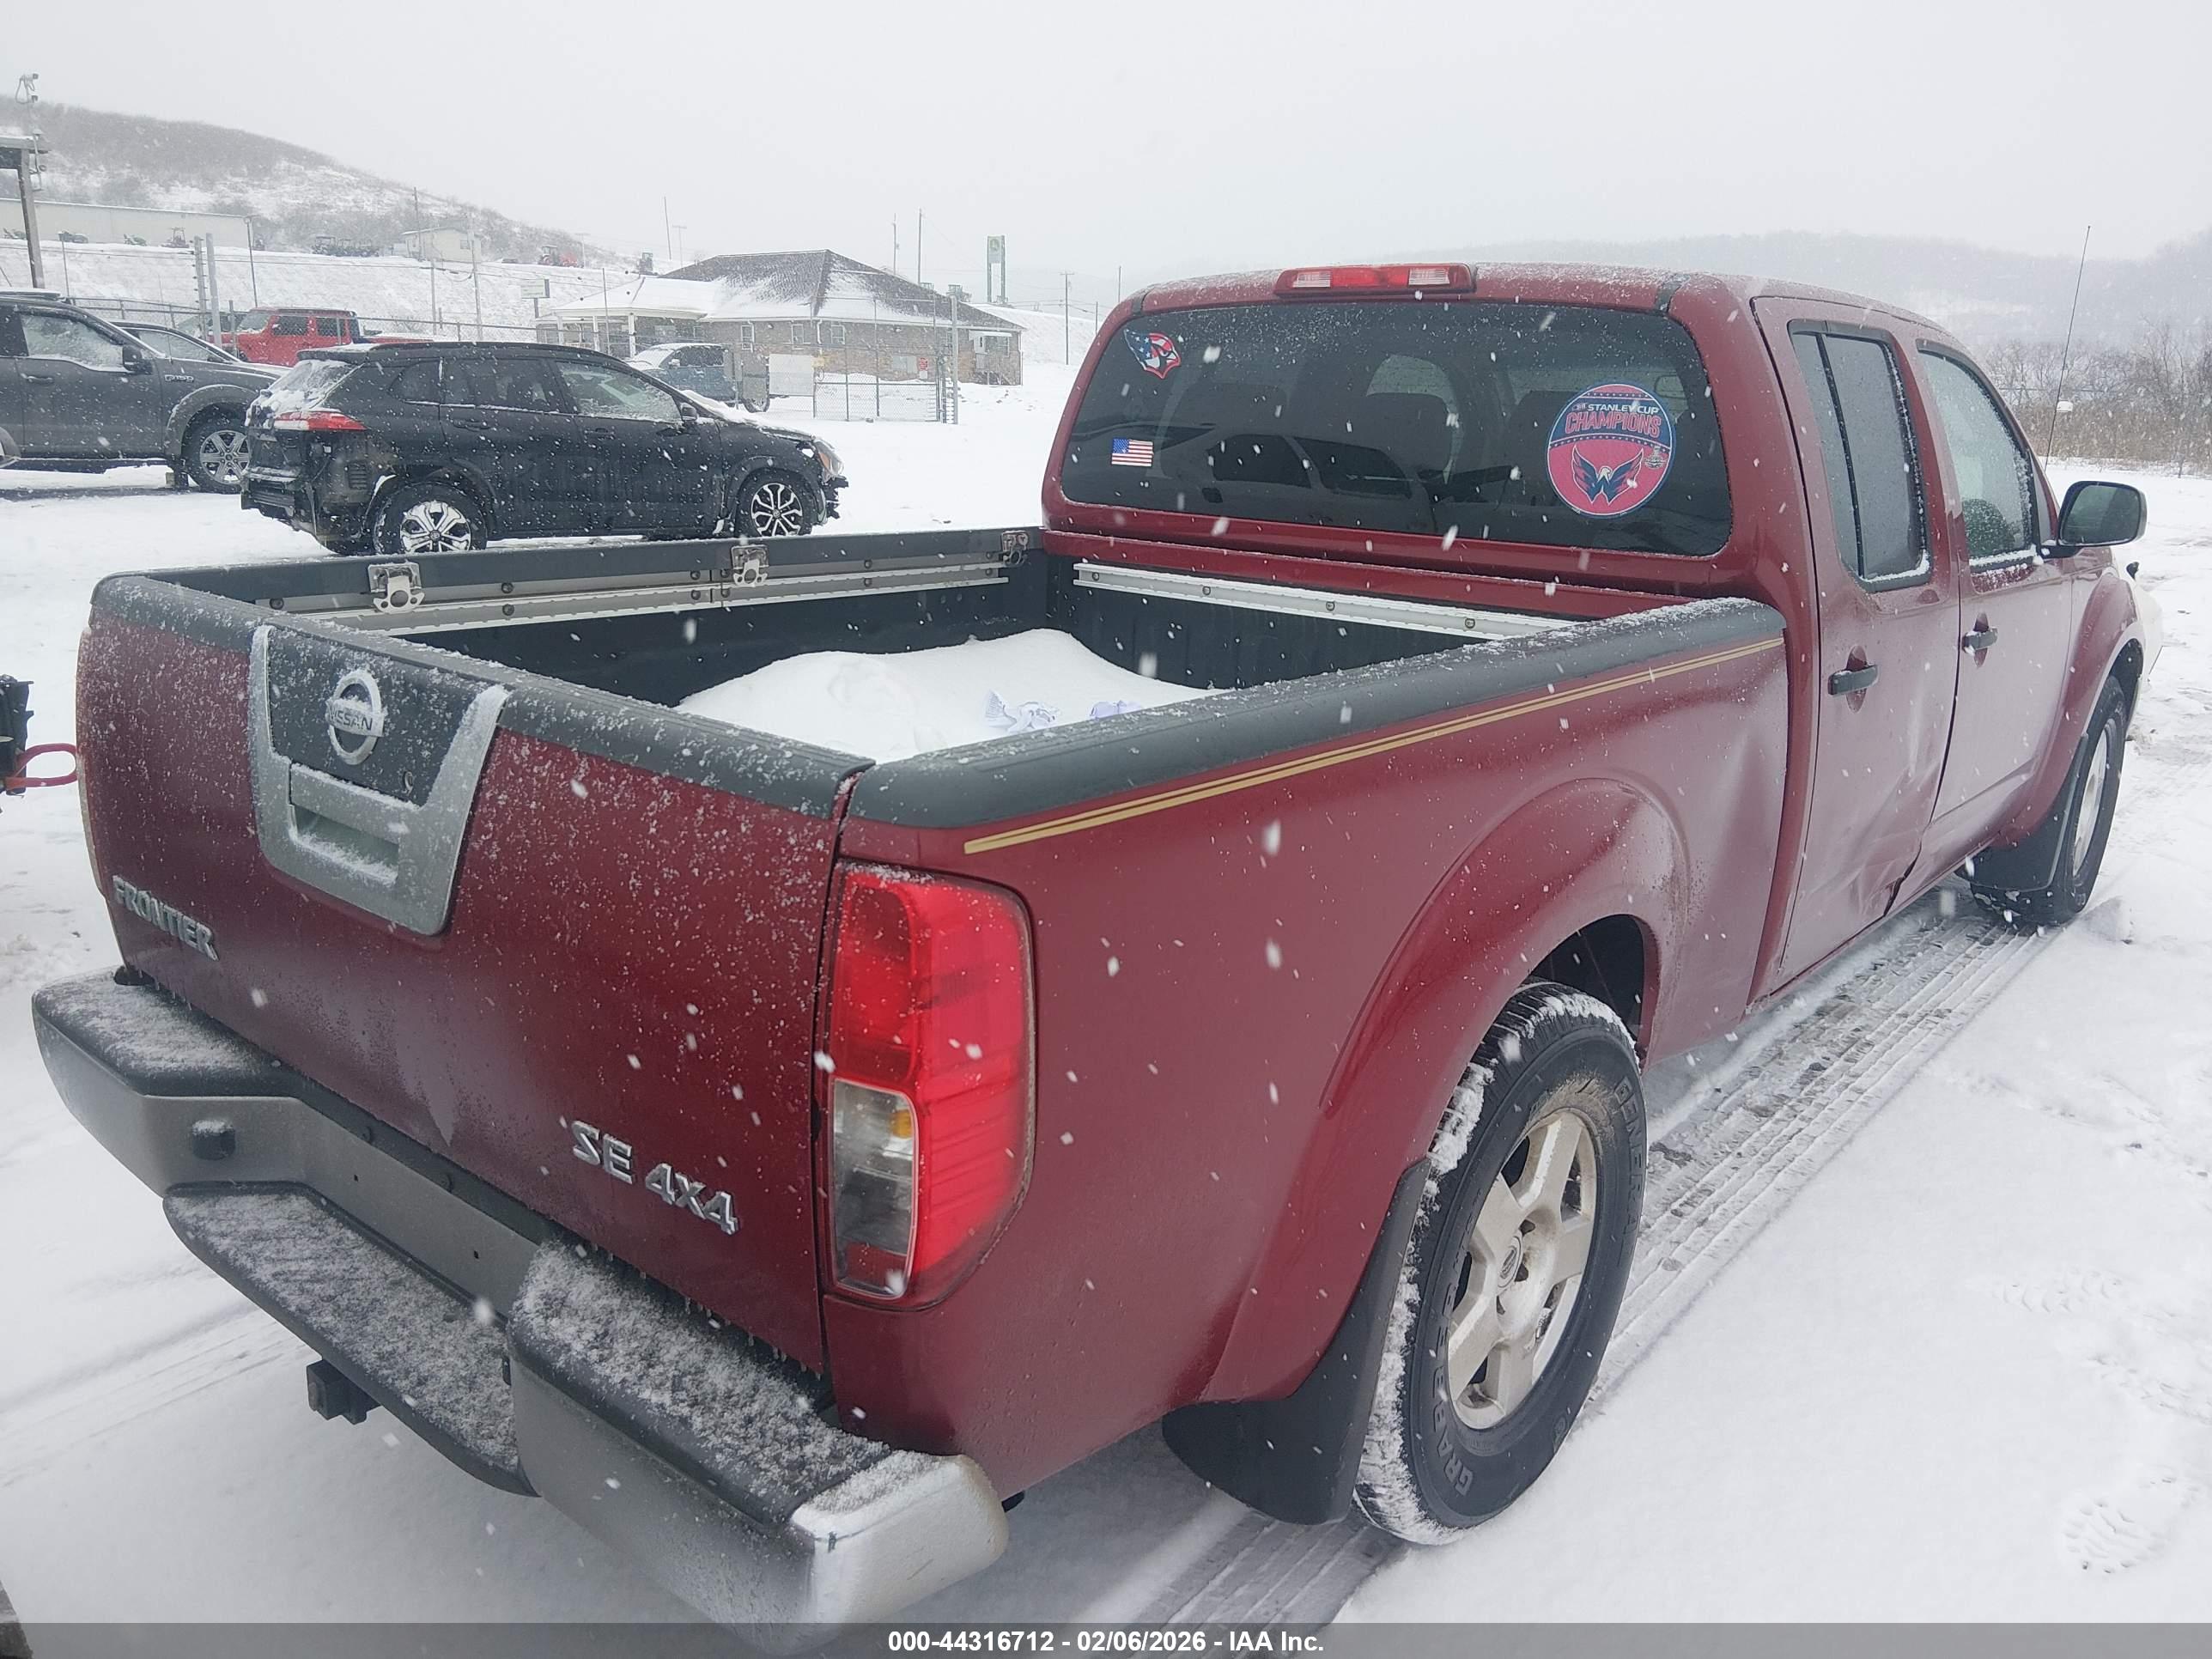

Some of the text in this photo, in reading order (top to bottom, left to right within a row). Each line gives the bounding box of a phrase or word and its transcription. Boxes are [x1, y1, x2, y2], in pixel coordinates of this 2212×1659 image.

[1565, 411, 1662, 438] CHAMPIONS
[1588, 403, 1638, 413] STANLEY
[1638, 405, 1659, 415] CUP
[329, 705, 373, 731] NISSAN
[112, 875, 219, 961] FRONTIER
[572, 1120, 634, 1185] SE
[1431, 1285, 1474, 1496] GRABBER
